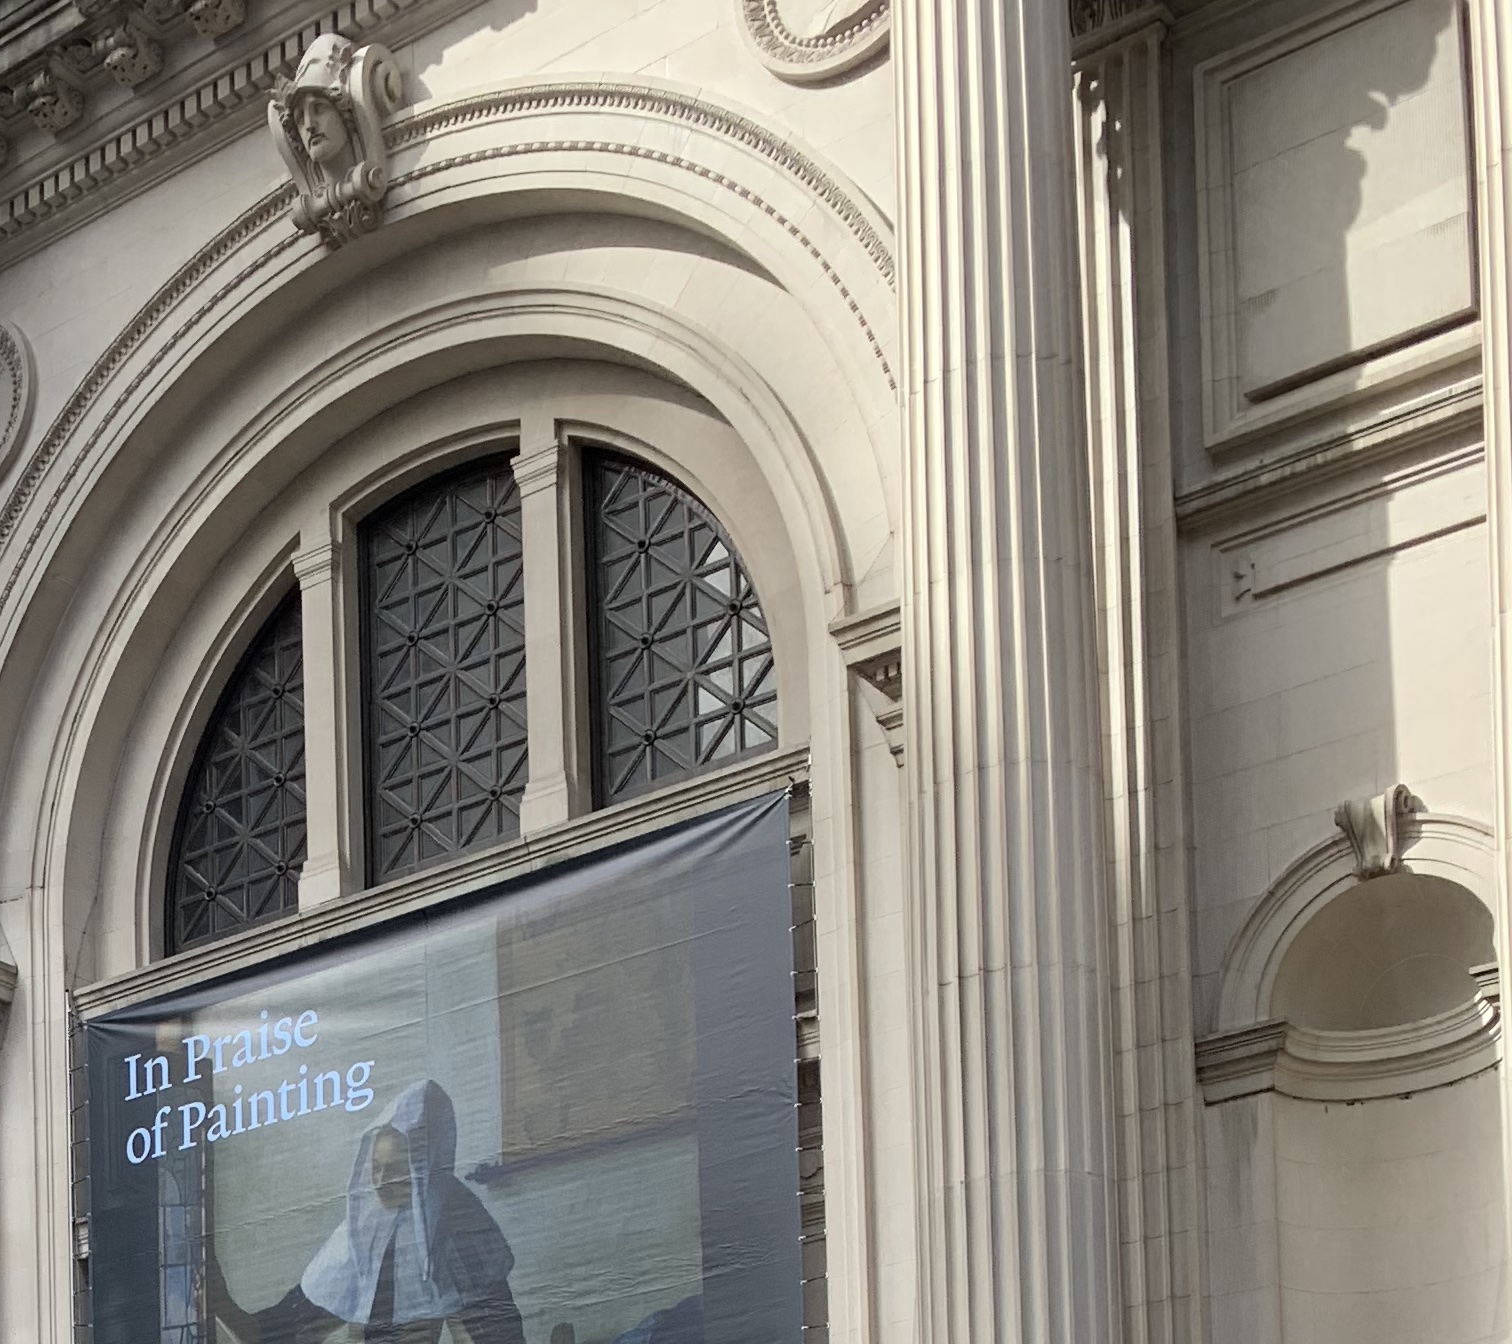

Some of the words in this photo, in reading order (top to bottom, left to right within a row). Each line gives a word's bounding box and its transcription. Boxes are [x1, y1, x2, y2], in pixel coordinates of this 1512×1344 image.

[124, 1053, 173, 1101] In
[182, 1009, 318, 1083] Praise
[126, 1105, 172, 1164] of
[178, 1060, 375, 1151] Painting
